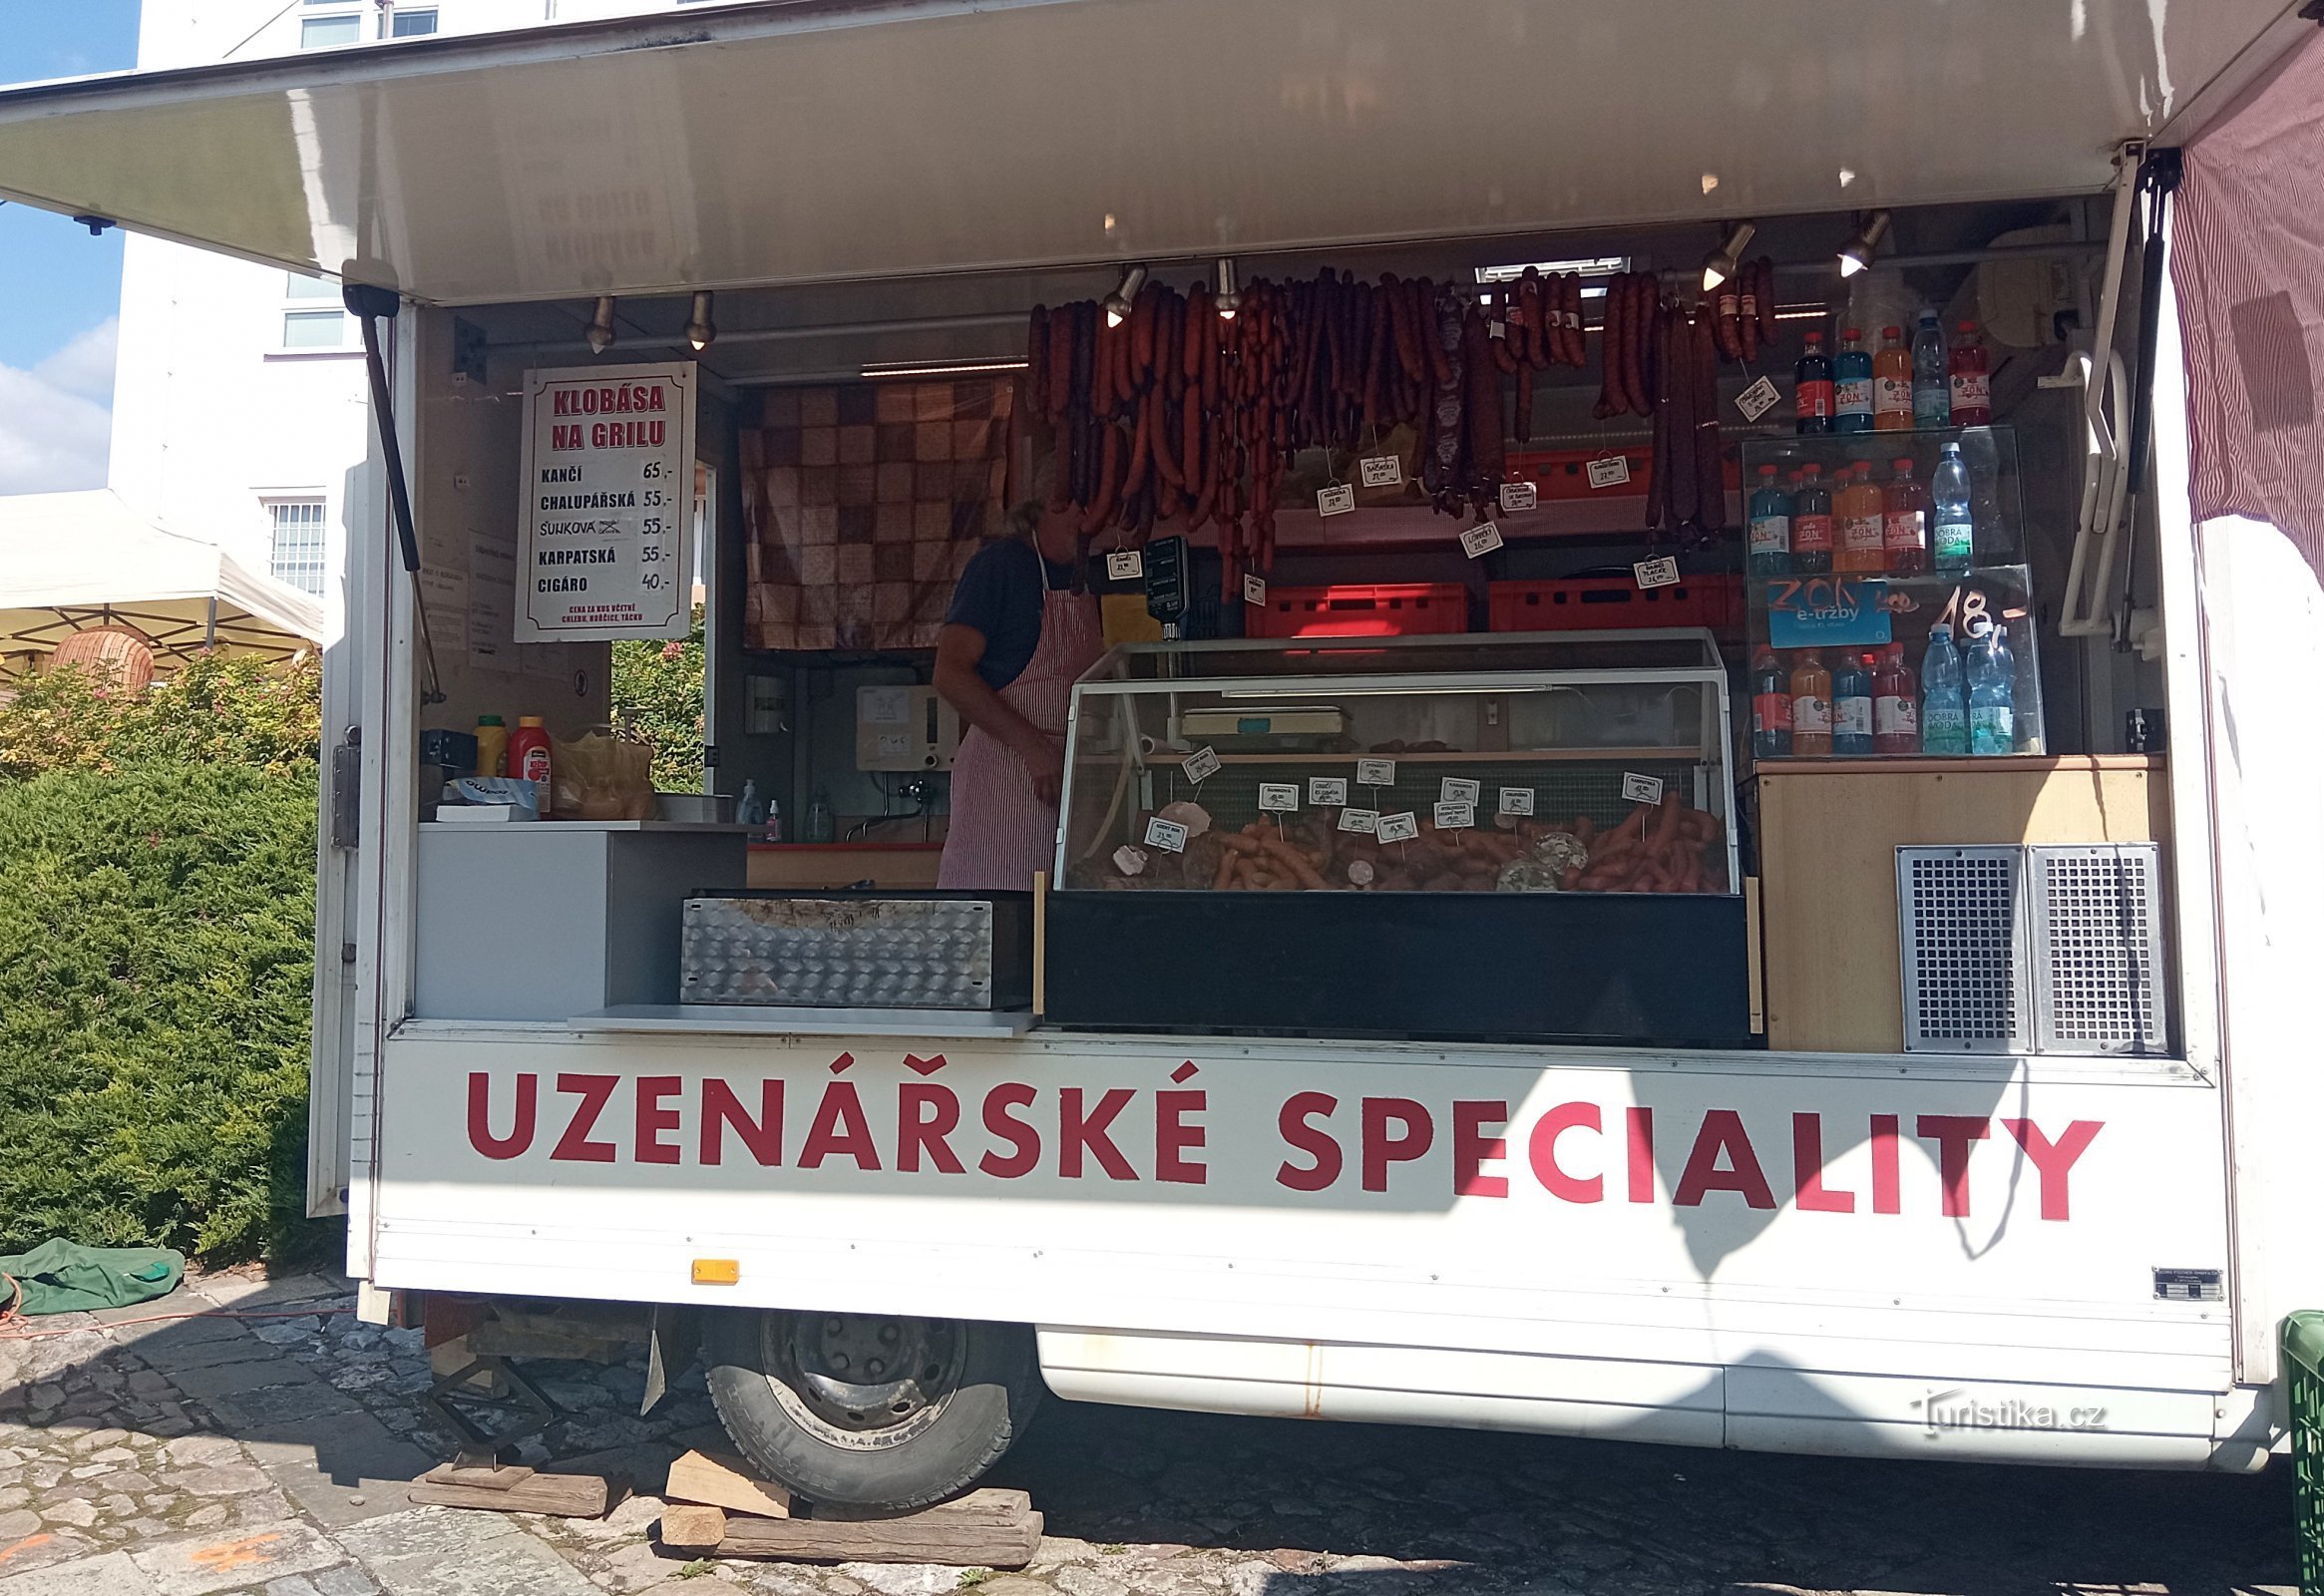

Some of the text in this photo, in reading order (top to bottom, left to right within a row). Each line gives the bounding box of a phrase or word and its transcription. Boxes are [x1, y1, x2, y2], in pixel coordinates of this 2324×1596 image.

[554, 383, 665, 416] KLOBÁSA
[552, 420, 666, 451] NA GRILU
[542, 465, 582, 483] KANČÍ
[541, 490, 635, 511] CHALUPÁŘSKÁ
[539, 547, 616, 567] KARPATSKÁ
[538, 577, 588, 594] CIGÁRO
[1796, 606, 1859, 621] e-tržby
[467, 1050, 2107, 1222] UZENÁŘSKÉ SPECIALITY
